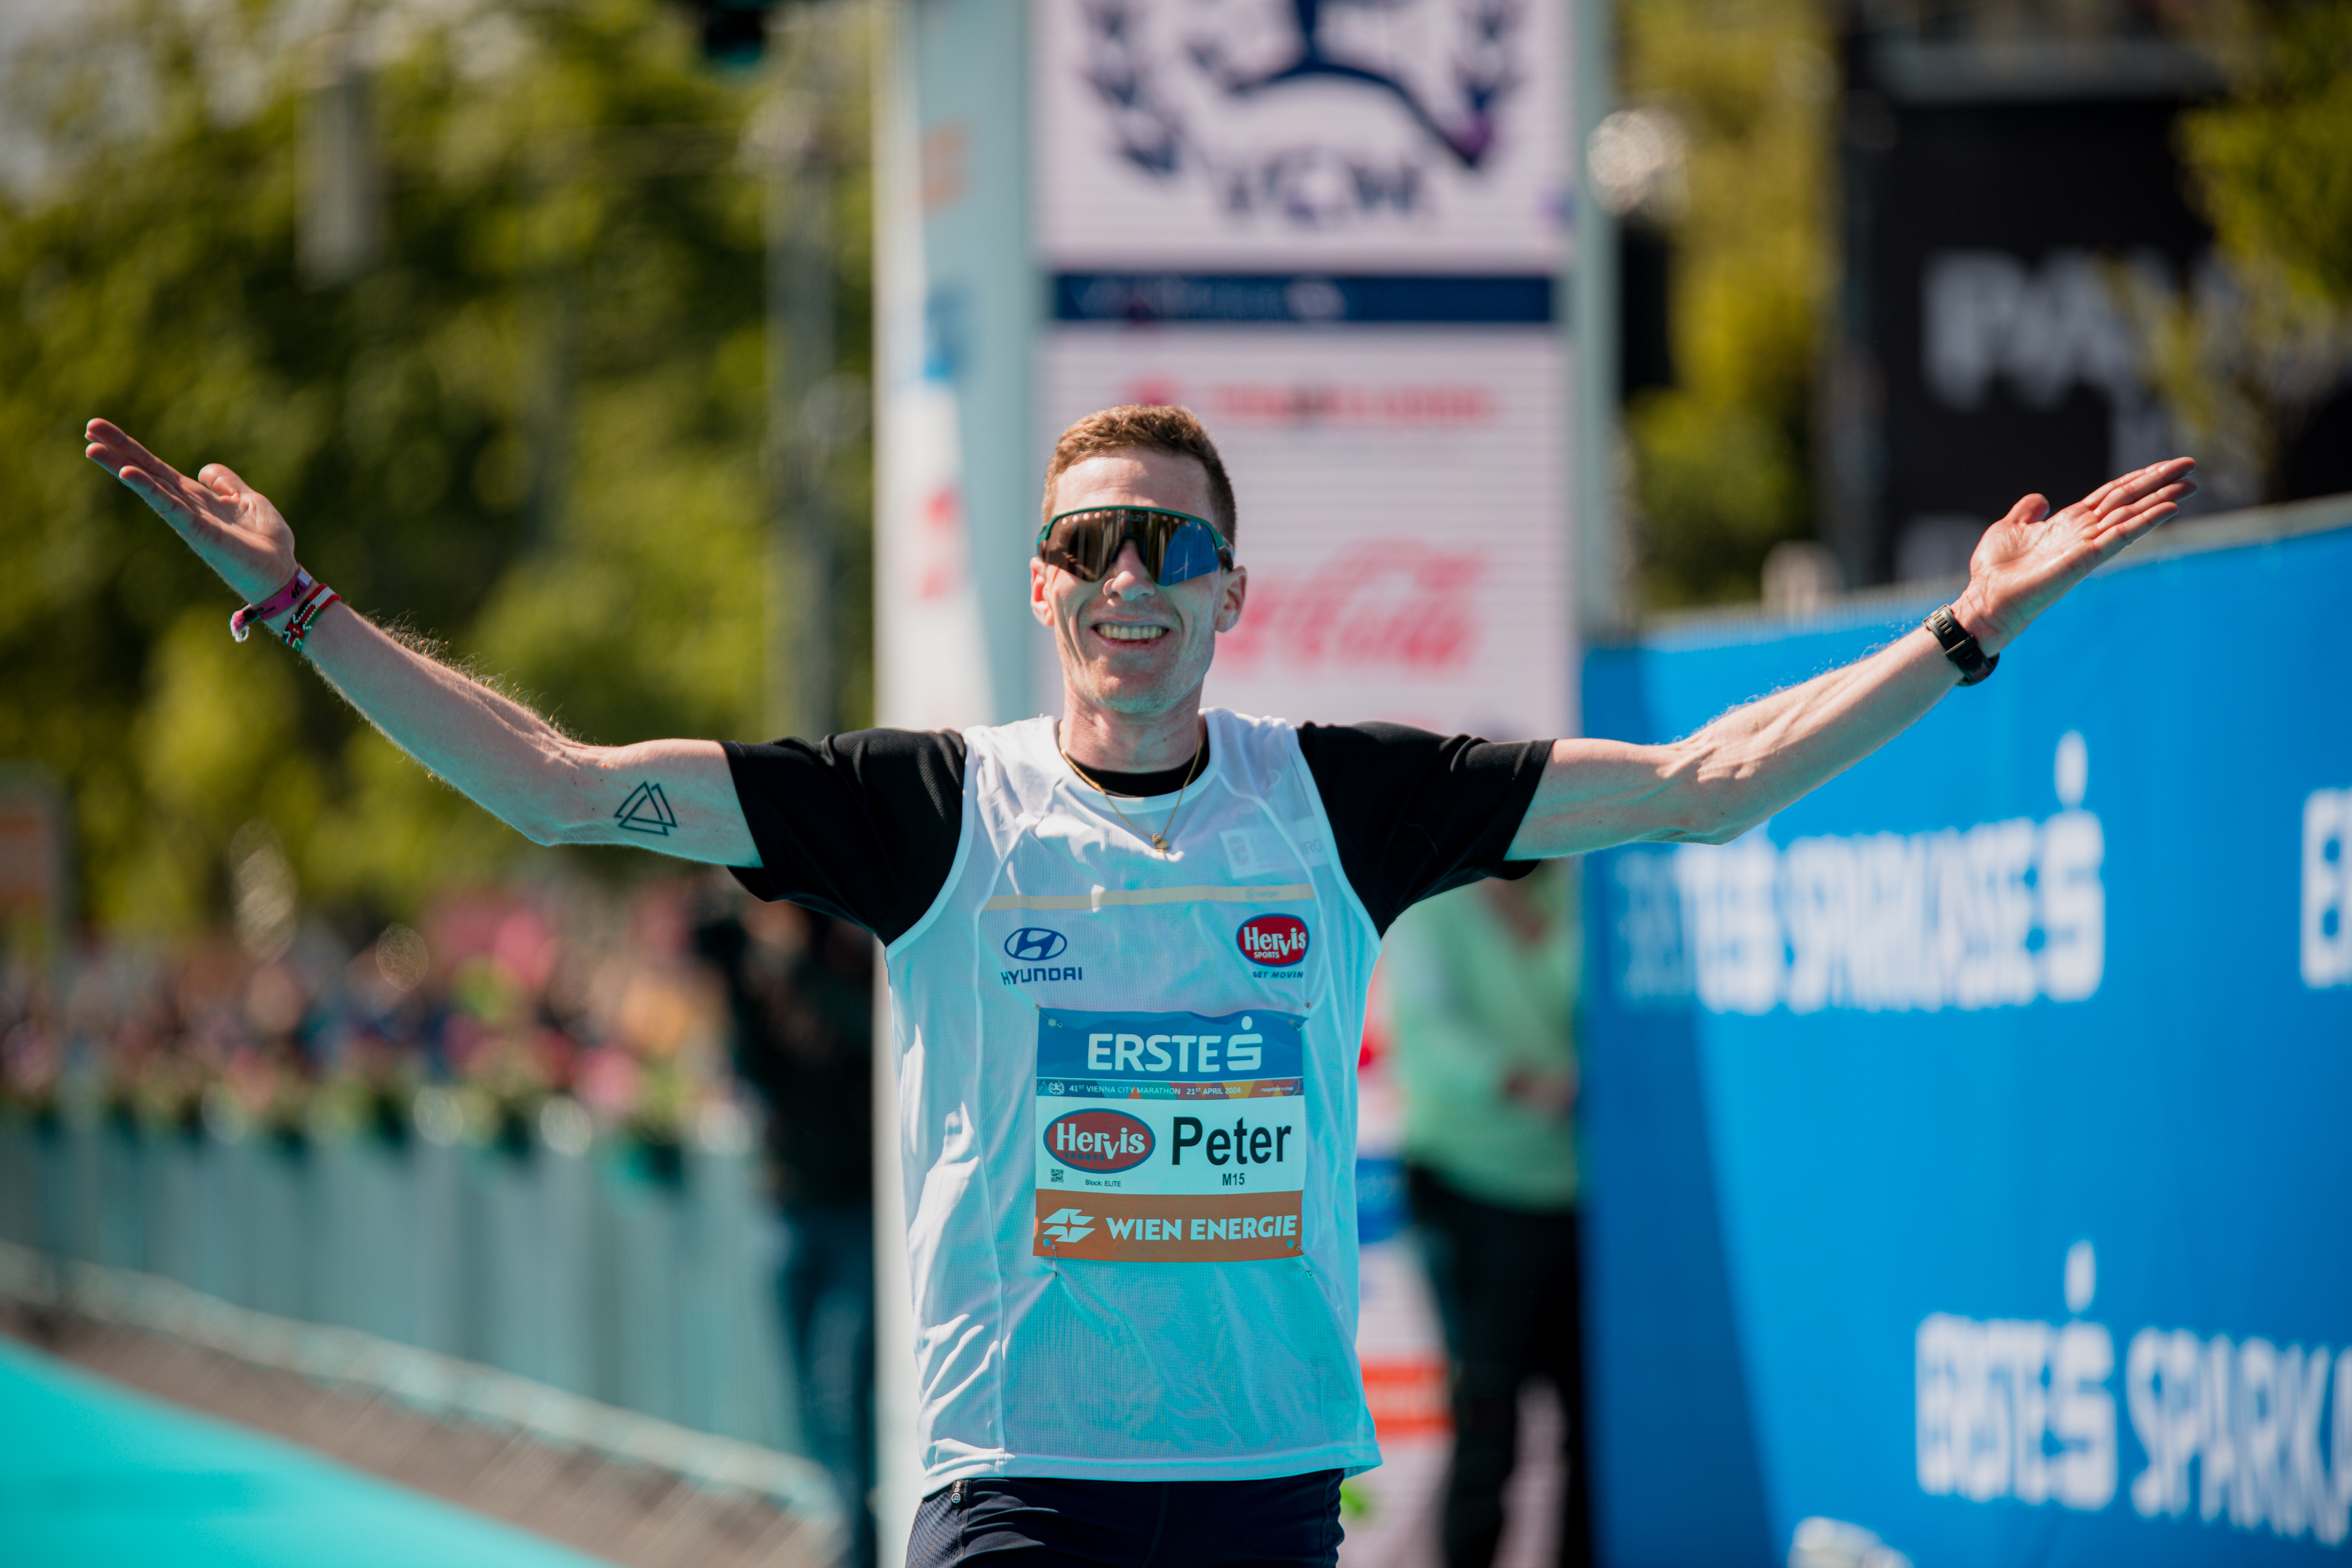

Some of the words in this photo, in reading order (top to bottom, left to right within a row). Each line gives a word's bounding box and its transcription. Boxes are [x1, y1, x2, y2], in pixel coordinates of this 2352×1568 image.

[1243, 926, 1306, 956] Hervis
[1000, 967, 1083, 985] HYUNDAI
[1087, 1033, 1222, 1073] ERSTE
[1137, 1086, 1181, 1095] MARATHON
[1202, 1087, 1224, 1095] APRIL
[1056, 1123, 1145, 1160] Hervis
[1171, 1116, 1292, 1166] Peter
[1063, 1152, 1105, 1162] SPORTS
[1222, 1173, 1245, 1186] M15
[1105, 1218, 1182, 1241] WIEN
[1190, 1215, 1298, 1240] ENERGIE
